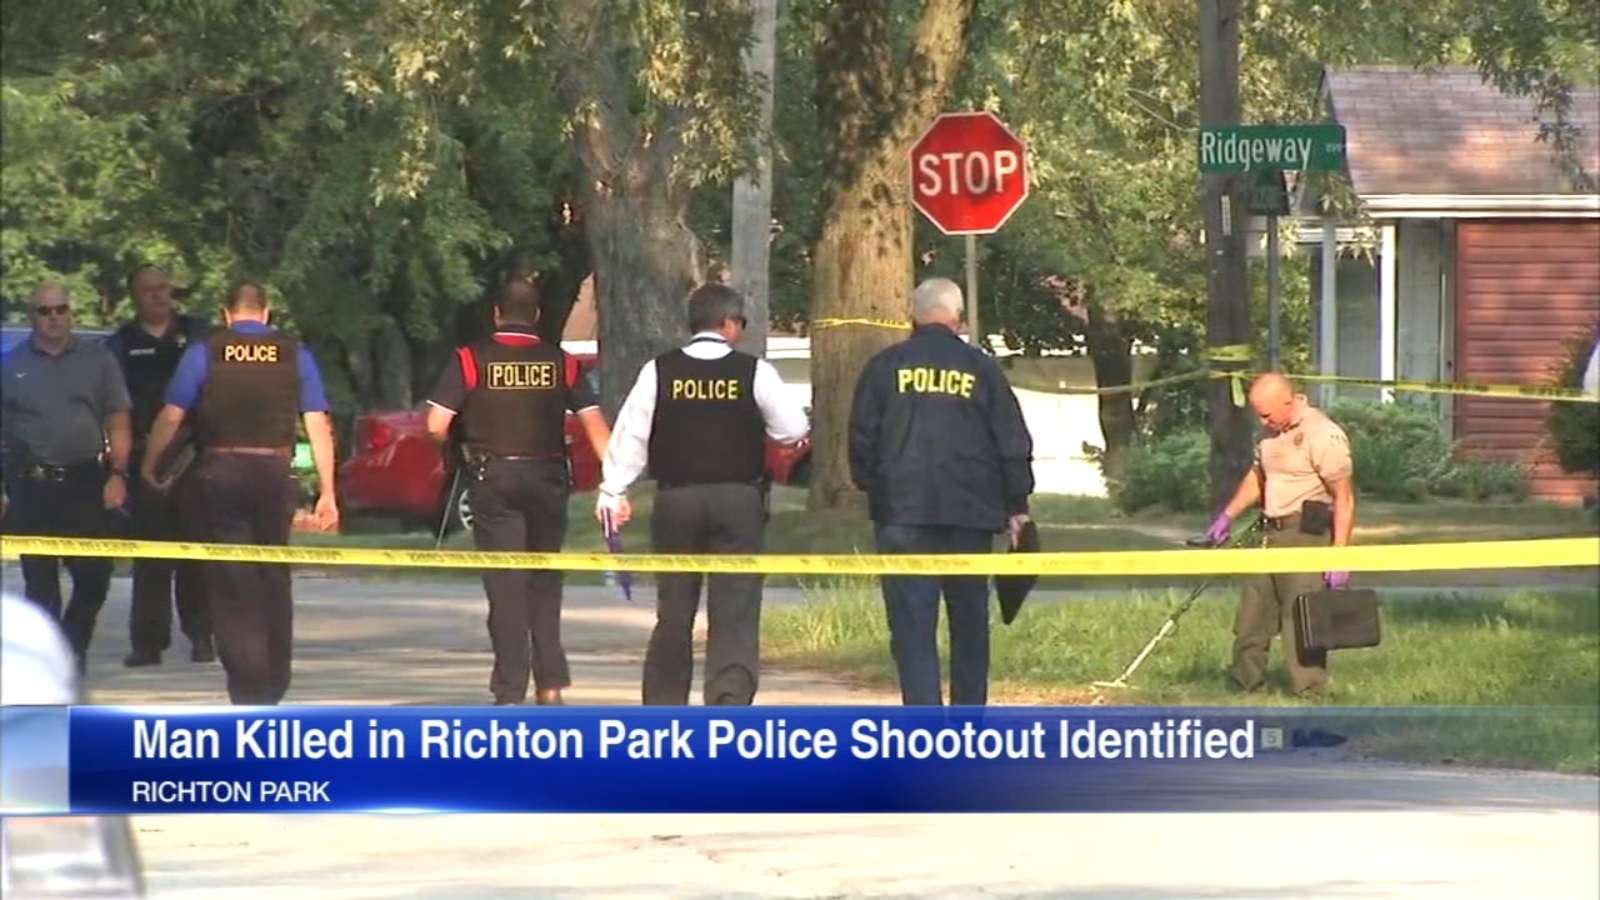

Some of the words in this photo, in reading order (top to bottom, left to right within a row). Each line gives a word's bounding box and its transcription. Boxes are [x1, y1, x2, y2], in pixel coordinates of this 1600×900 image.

[1202, 131, 1312, 171] Ridgeway
[919, 150, 1018, 197] STOP
[225, 345, 277, 361] POLICE
[493, 365, 551, 386] POLICE
[898, 368, 975, 397] POLICE
[673, 380, 738, 399] POLICE
